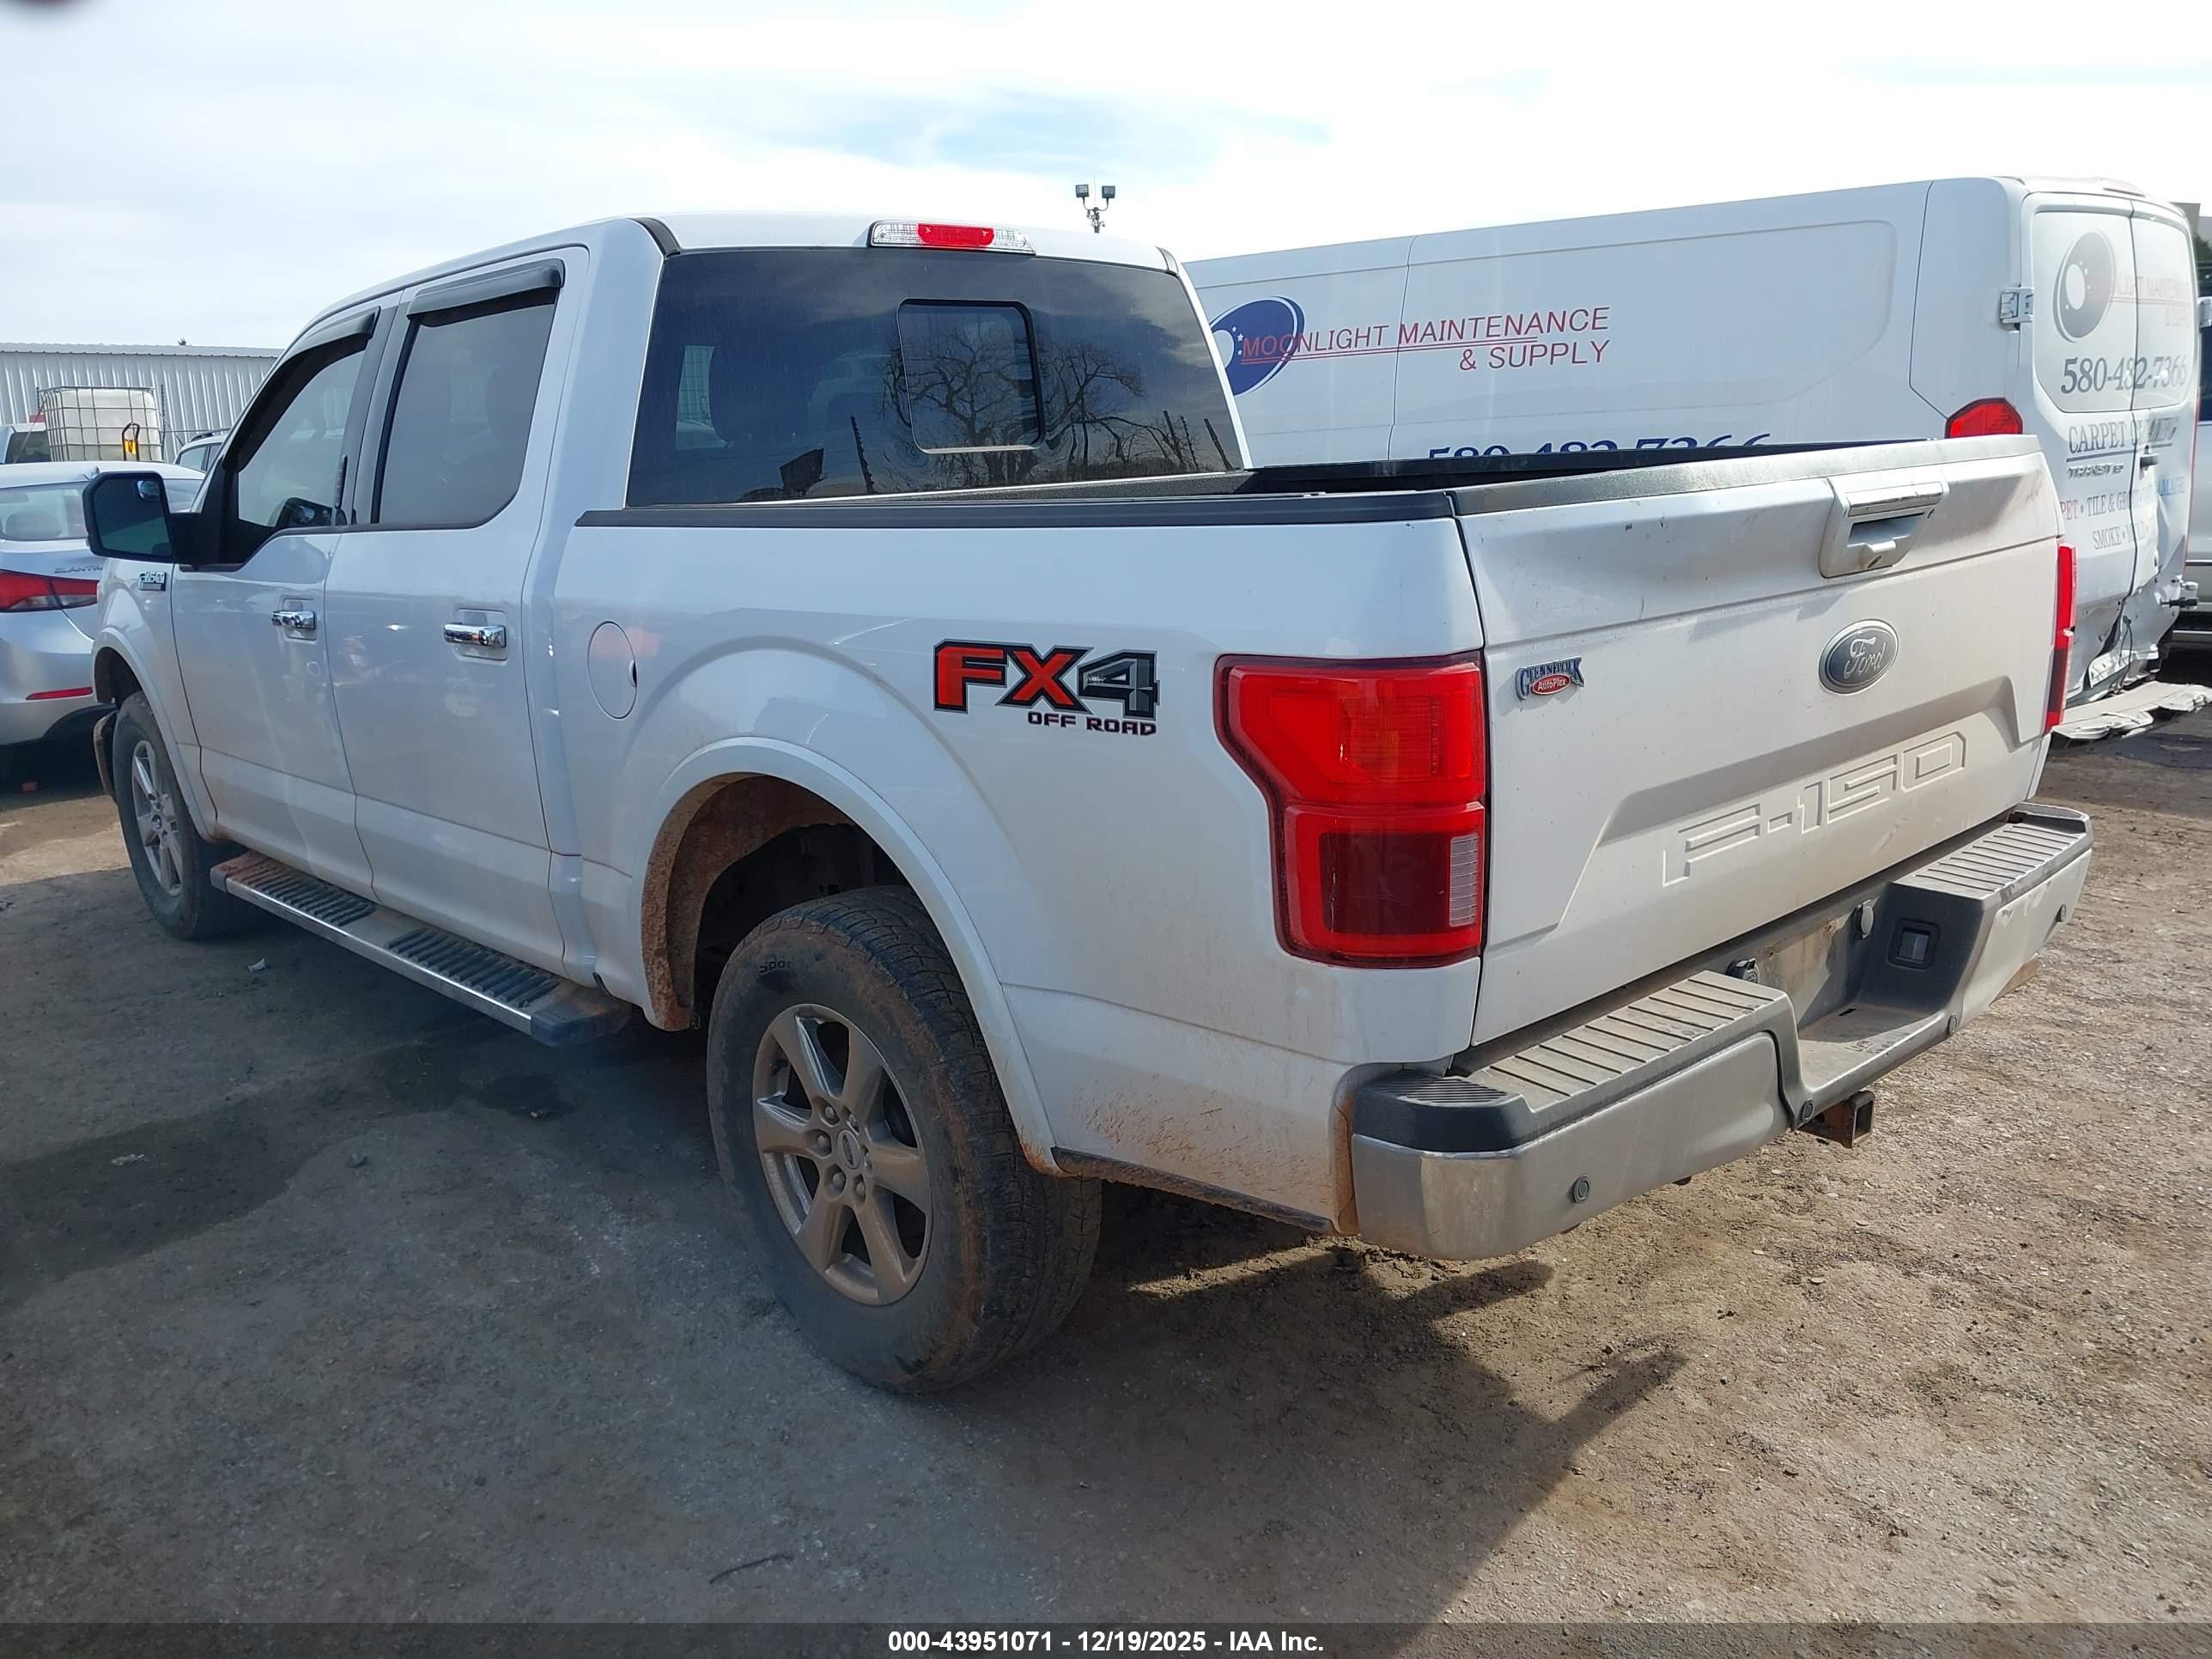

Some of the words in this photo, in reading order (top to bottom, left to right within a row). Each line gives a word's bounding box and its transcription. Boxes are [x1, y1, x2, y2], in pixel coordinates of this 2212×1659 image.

[1242, 324, 1389, 357] MOONLIGHT
[1398, 306, 1610, 345] MAINTENANCE
[1460, 348, 1478, 371] &
[1488, 340, 1611, 368] SUPPLY
[2061, 356, 2187, 394] 580-482-7366
[2068, 420, 2128, 453] CARPET
[2092, 526, 2122, 550] SMOKE
[1843, 636, 1887, 679] Ford
[933, 638, 1160, 721] FX4
[1027, 711, 1077, 728] OFF
[1085, 716, 1157, 736] ROAD
[1662, 731, 1966, 888] F-150
